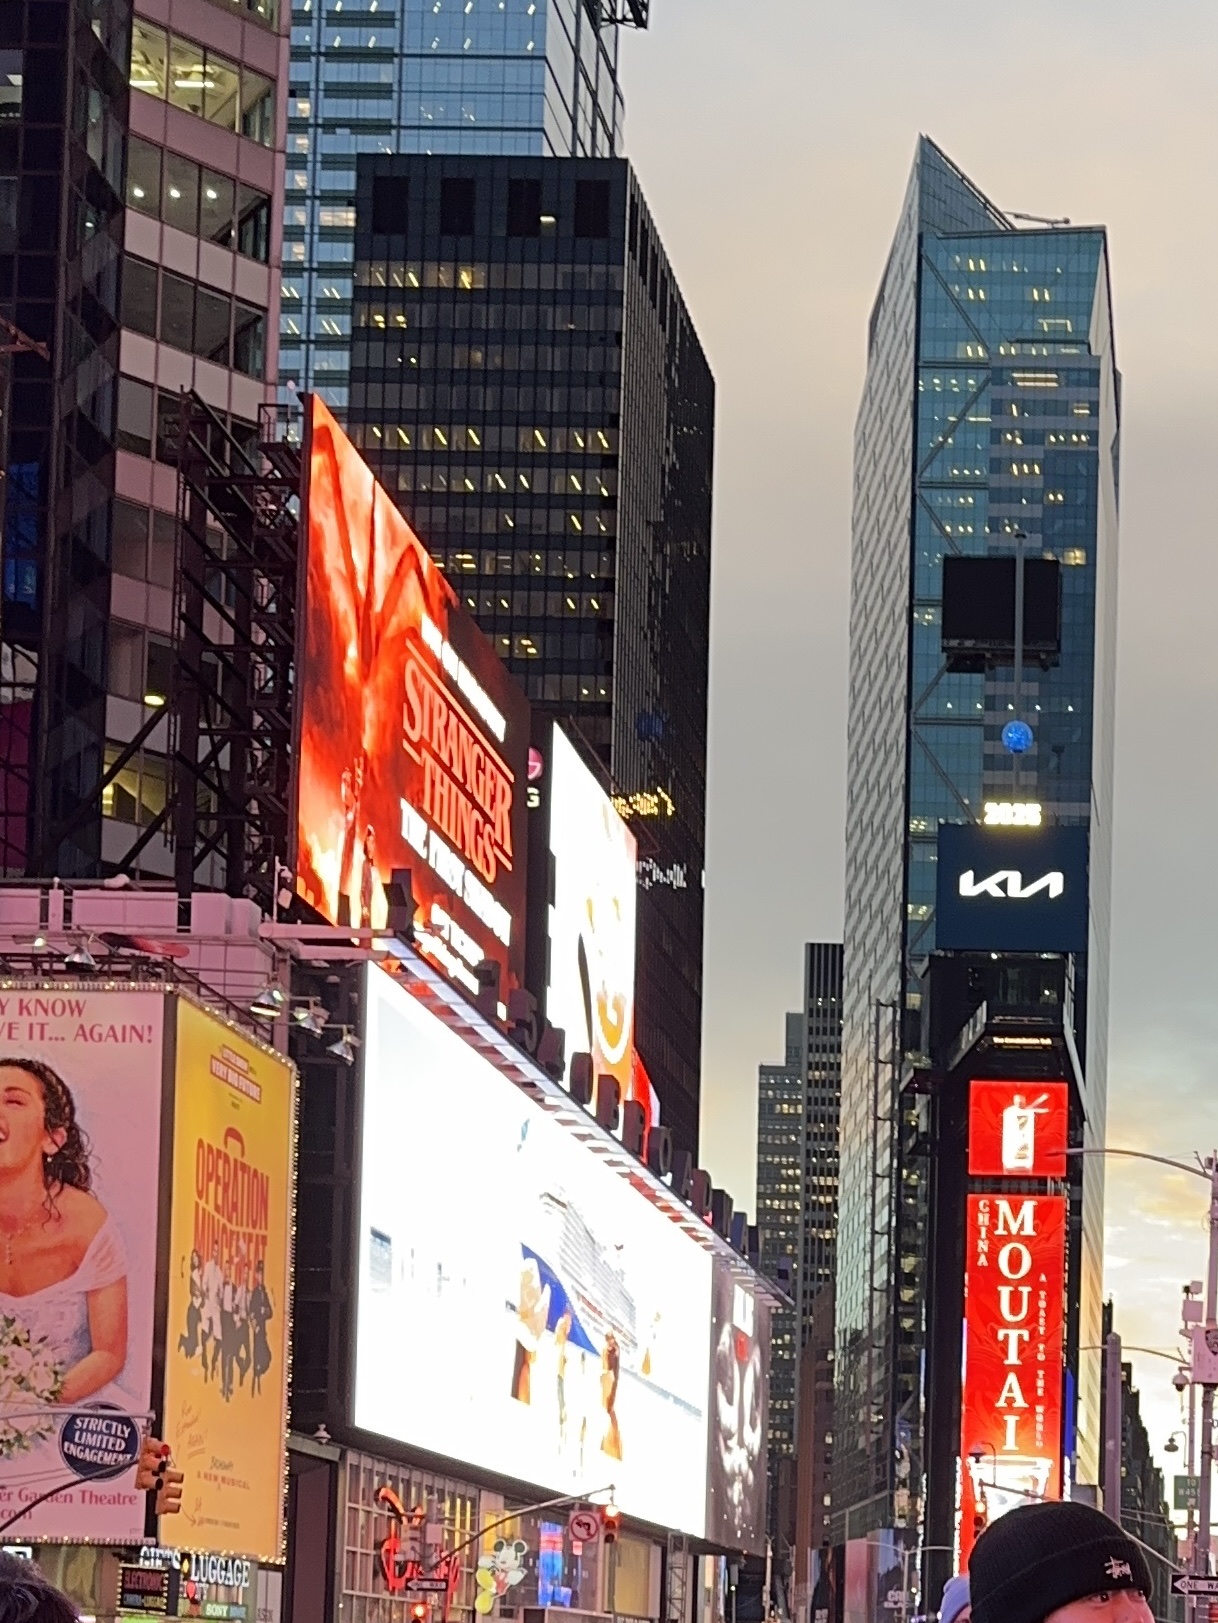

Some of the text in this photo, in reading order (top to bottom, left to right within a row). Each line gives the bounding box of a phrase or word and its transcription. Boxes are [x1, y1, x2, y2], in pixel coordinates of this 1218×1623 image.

[402, 658, 513, 857] STRANGER
[421, 747, 498, 883] THINGS
[18, 998, 87, 1018] KNOW
[28, 1022, 65, 1041] IT...
[73, 1023, 153, 1044] AGAIN!
[195, 1138, 269, 1231] OPERATION
[977, 1199, 990, 1267] CHINA
[994, 1199, 1037, 1450] MOUTAI
[74, 1417, 131, 1439] STRICTLY
[74, 1430, 126, 1451] LIMITED
[79, 1489, 137, 1505] Theatre
[191, 1554, 251, 1587] LUGGAGE
[1180, 1580, 1198, 1590] ONE
[206, 1604, 228, 1618] SONY
